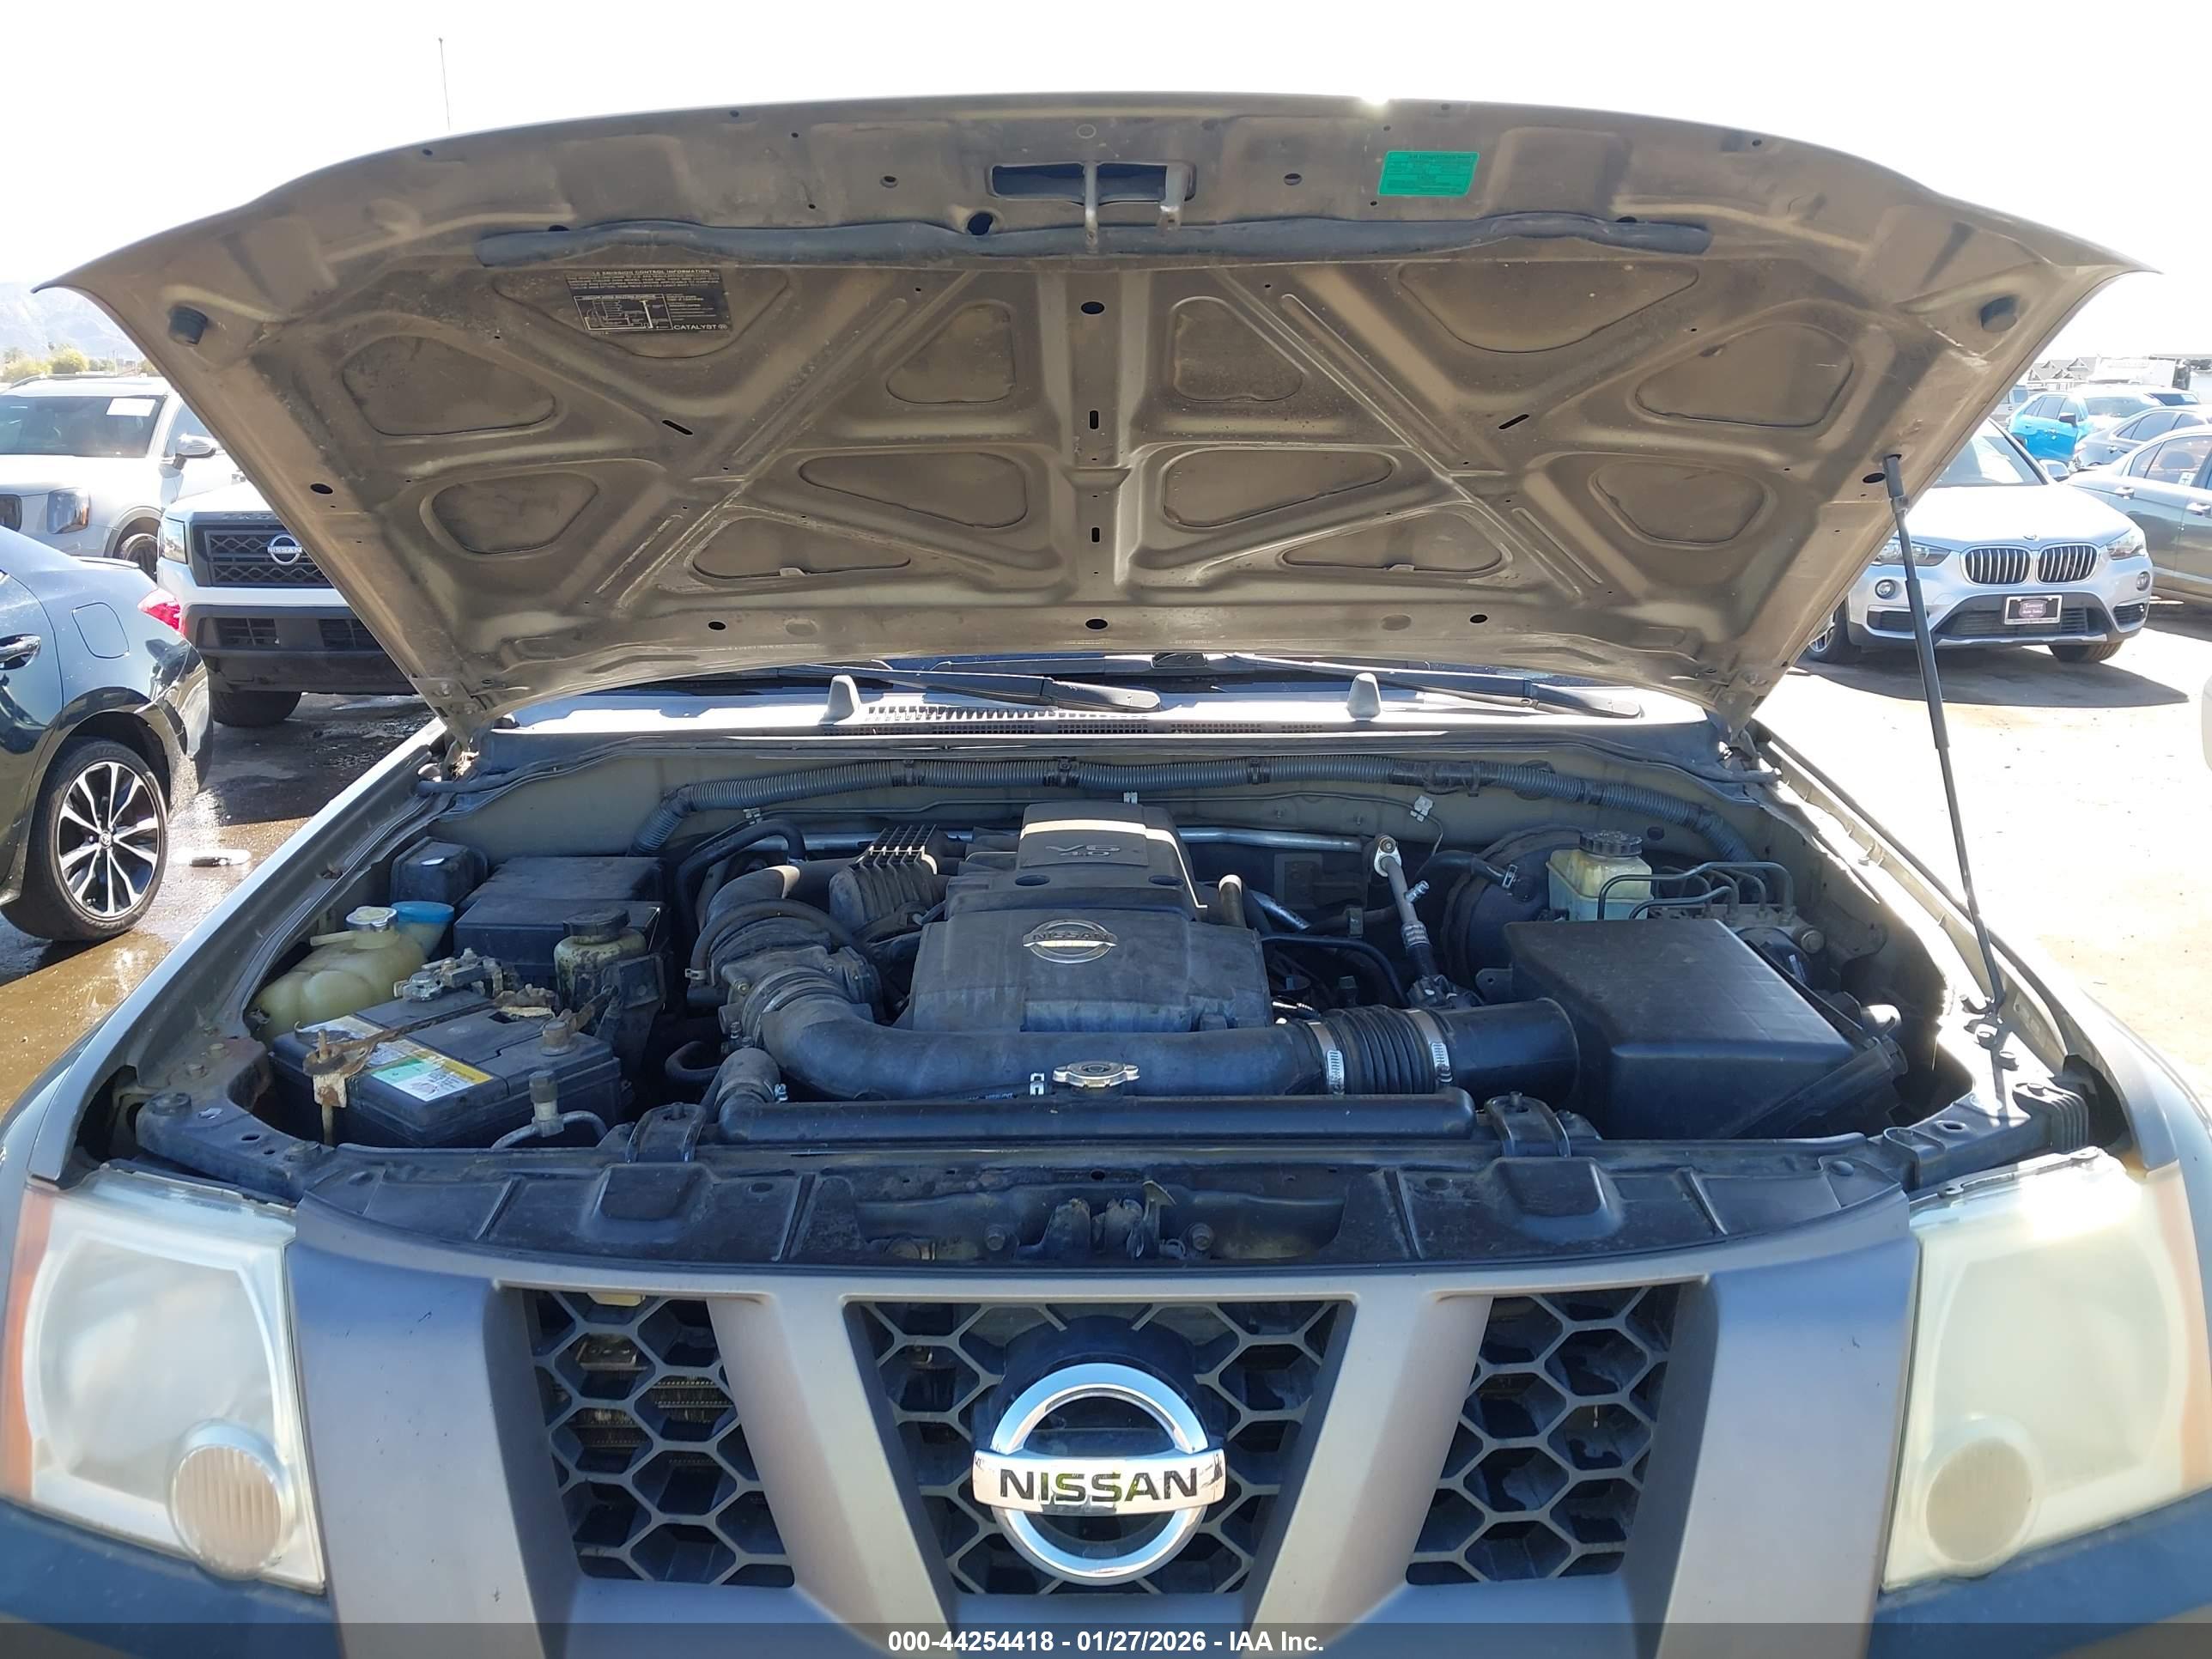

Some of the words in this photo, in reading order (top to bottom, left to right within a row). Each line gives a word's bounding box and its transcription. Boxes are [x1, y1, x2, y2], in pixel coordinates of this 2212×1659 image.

[268, 545, 301, 554] NISSAN
[1033, 930, 1109, 940] NISSAN
[1000, 1468, 1197, 1503] NISSAN
